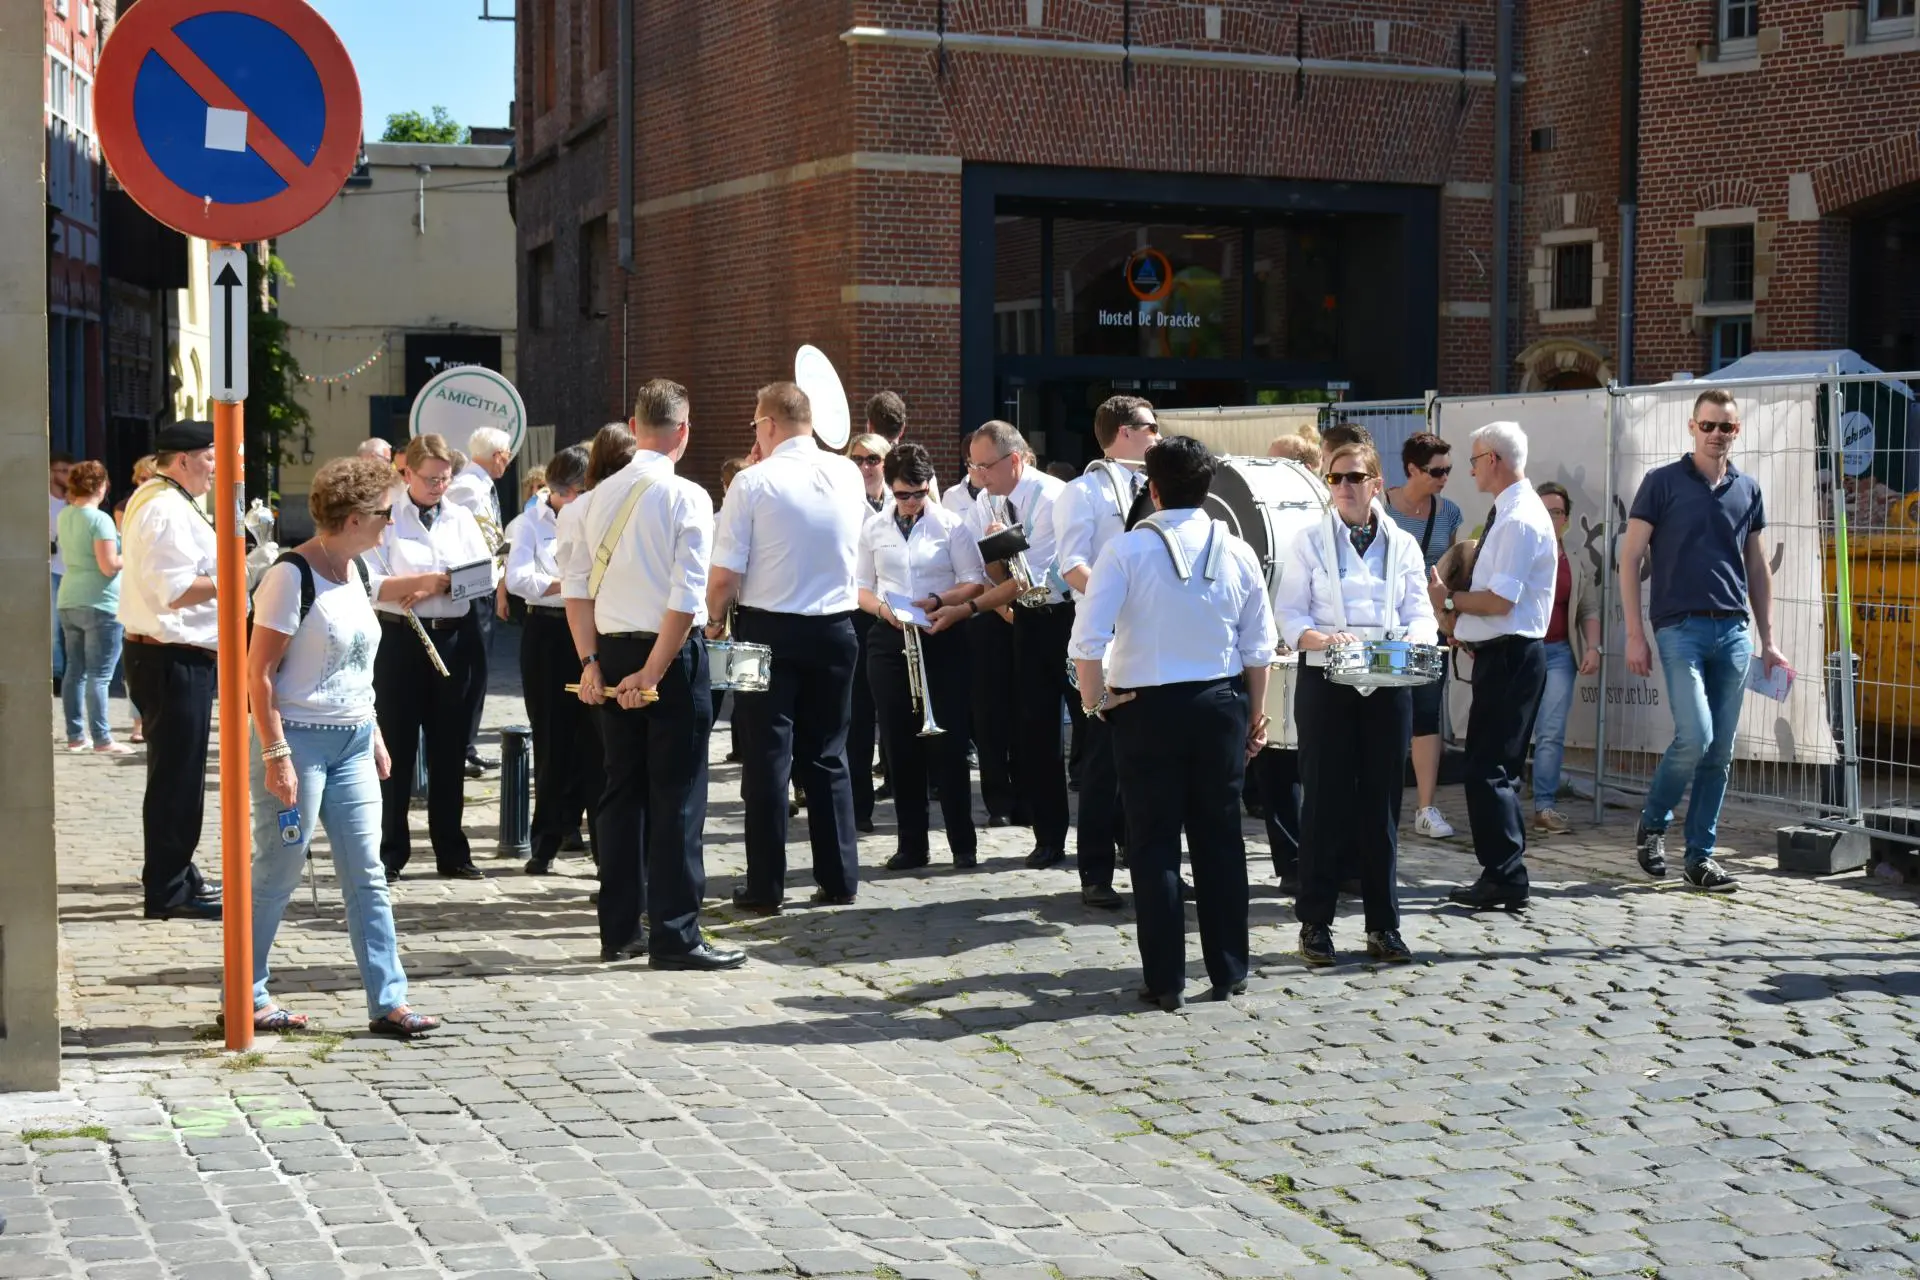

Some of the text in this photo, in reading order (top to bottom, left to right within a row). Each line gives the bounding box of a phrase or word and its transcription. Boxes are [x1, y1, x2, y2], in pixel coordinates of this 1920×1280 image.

[1098, 309, 1200, 328] Hostel De Draecke
[436, 387, 509, 416] AMICITIA
